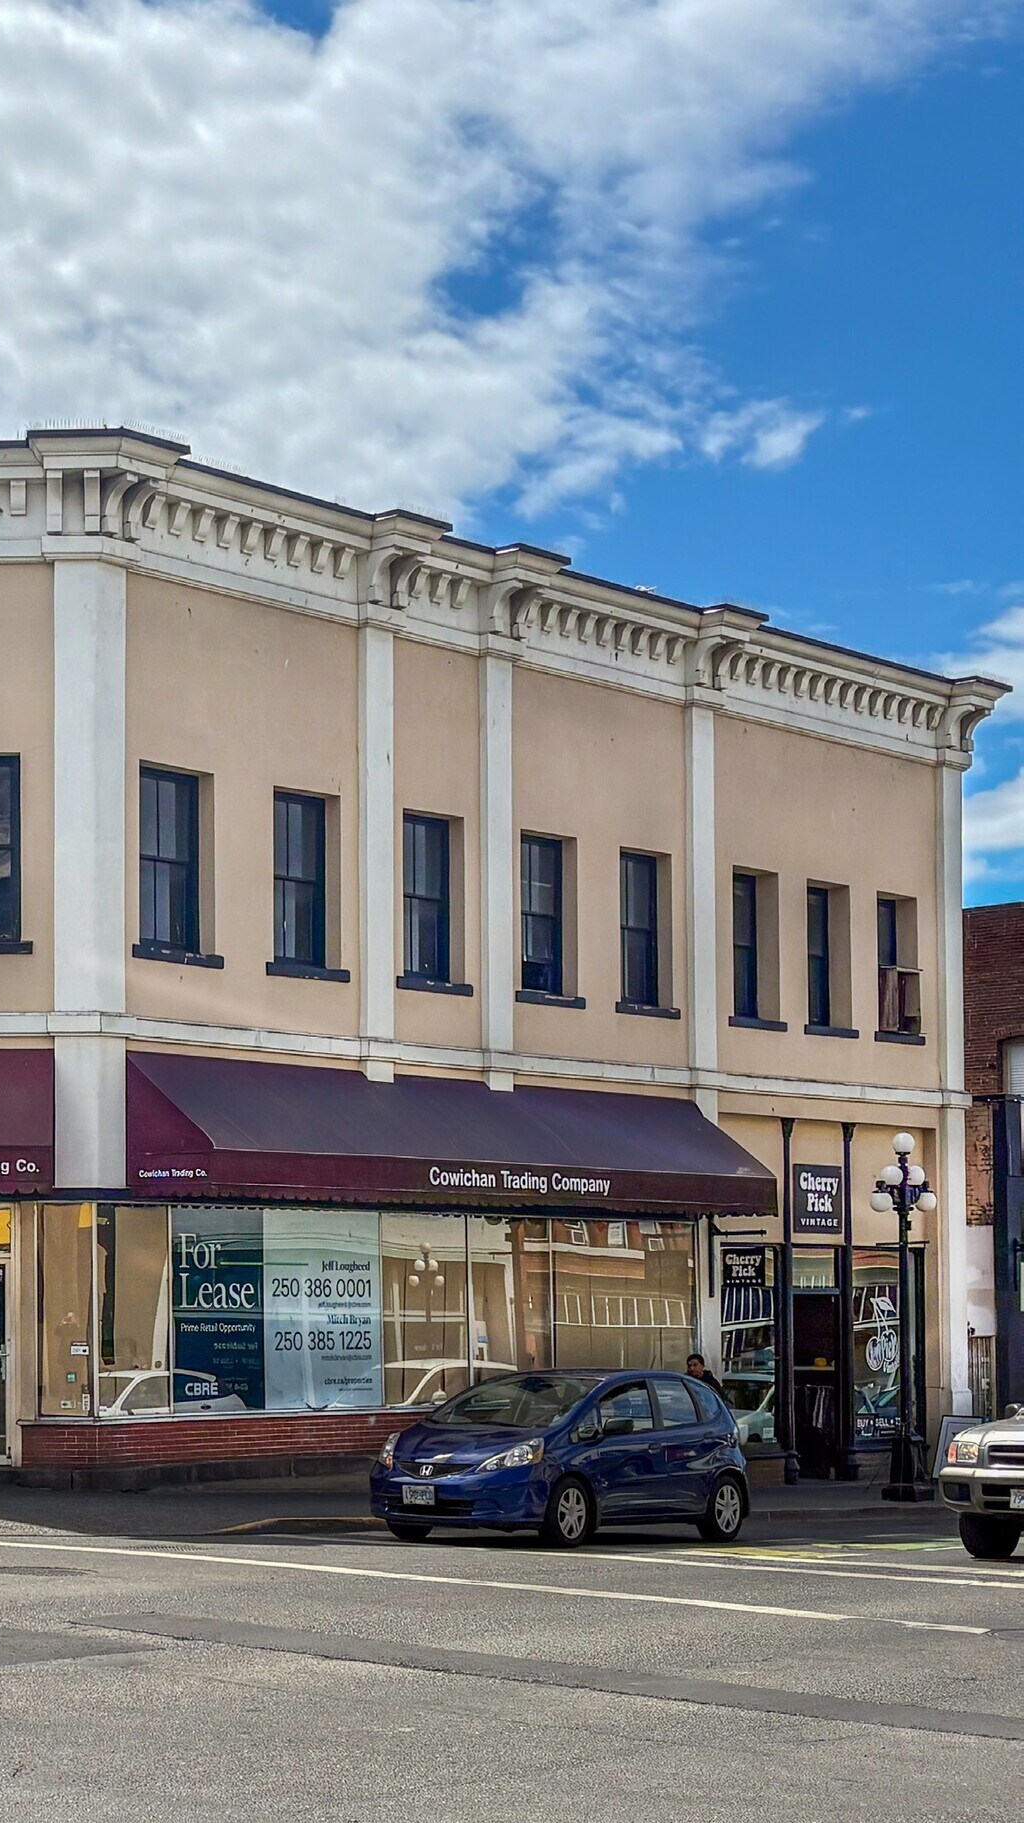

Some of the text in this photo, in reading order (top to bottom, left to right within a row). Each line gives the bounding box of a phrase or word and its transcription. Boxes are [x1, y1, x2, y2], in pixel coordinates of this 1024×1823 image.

[15, 1159, 40, 1173] Co.
[138, 1168, 208, 1178] Cowichan Trading Co.
[429, 1166, 611, 1196] Cowichan Trading Company
[799, 1171, 839, 1196] Cherry
[806, 1193, 833, 1213] Pick
[800, 1218, 839, 1227] VINTAGE
[178, 1233, 221, 1269] For
[321, 1260, 371, 1273] Jeff Lougheed
[725, 1253, 762, 1267] Cherry
[731, 1265, 756, 1277] Pick
[179, 1272, 256, 1309] Lease
[272, 1278, 372, 1298] 250 386 0001
[327, 1314, 371, 1327] Mitch Bryan
[180, 1322, 256, 1334] Prime Retail Opportunity
[274, 1331, 303, 1351] 250
[308, 1331, 335, 1351] 385
[339, 1331, 372, 1351] 1225
[185, 1382, 219, 1396] CBRE
